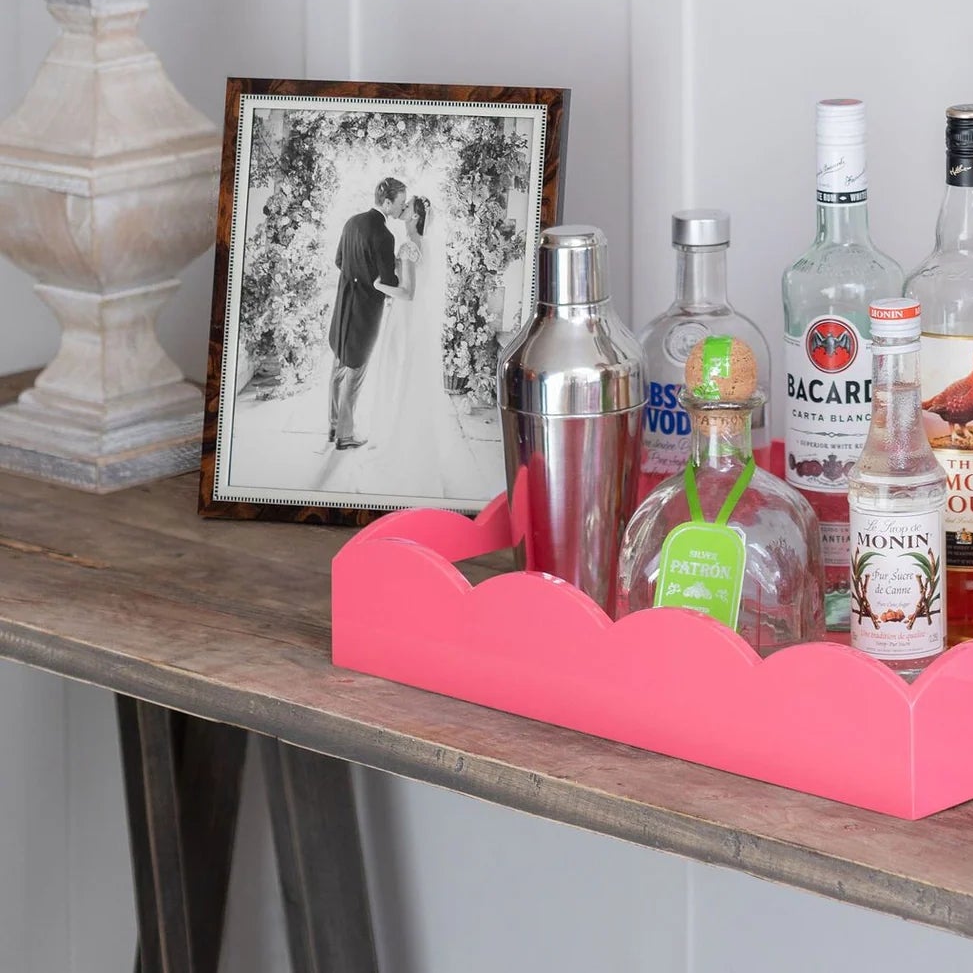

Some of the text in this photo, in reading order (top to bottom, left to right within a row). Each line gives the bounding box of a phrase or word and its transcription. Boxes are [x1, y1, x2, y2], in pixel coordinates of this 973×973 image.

[871, 309, 903, 319] MONIN
[792, 409, 825, 422] CARTA
[800, 440, 828, 449] SUPERIOR
[864, 518, 878, 531] Le
[857, 531, 929, 549] MONIN
[670, 559, 732, 579] PATRÓN
[871, 568, 914, 583] Pur Sucre
[875, 584, 911, 595] de Canne
